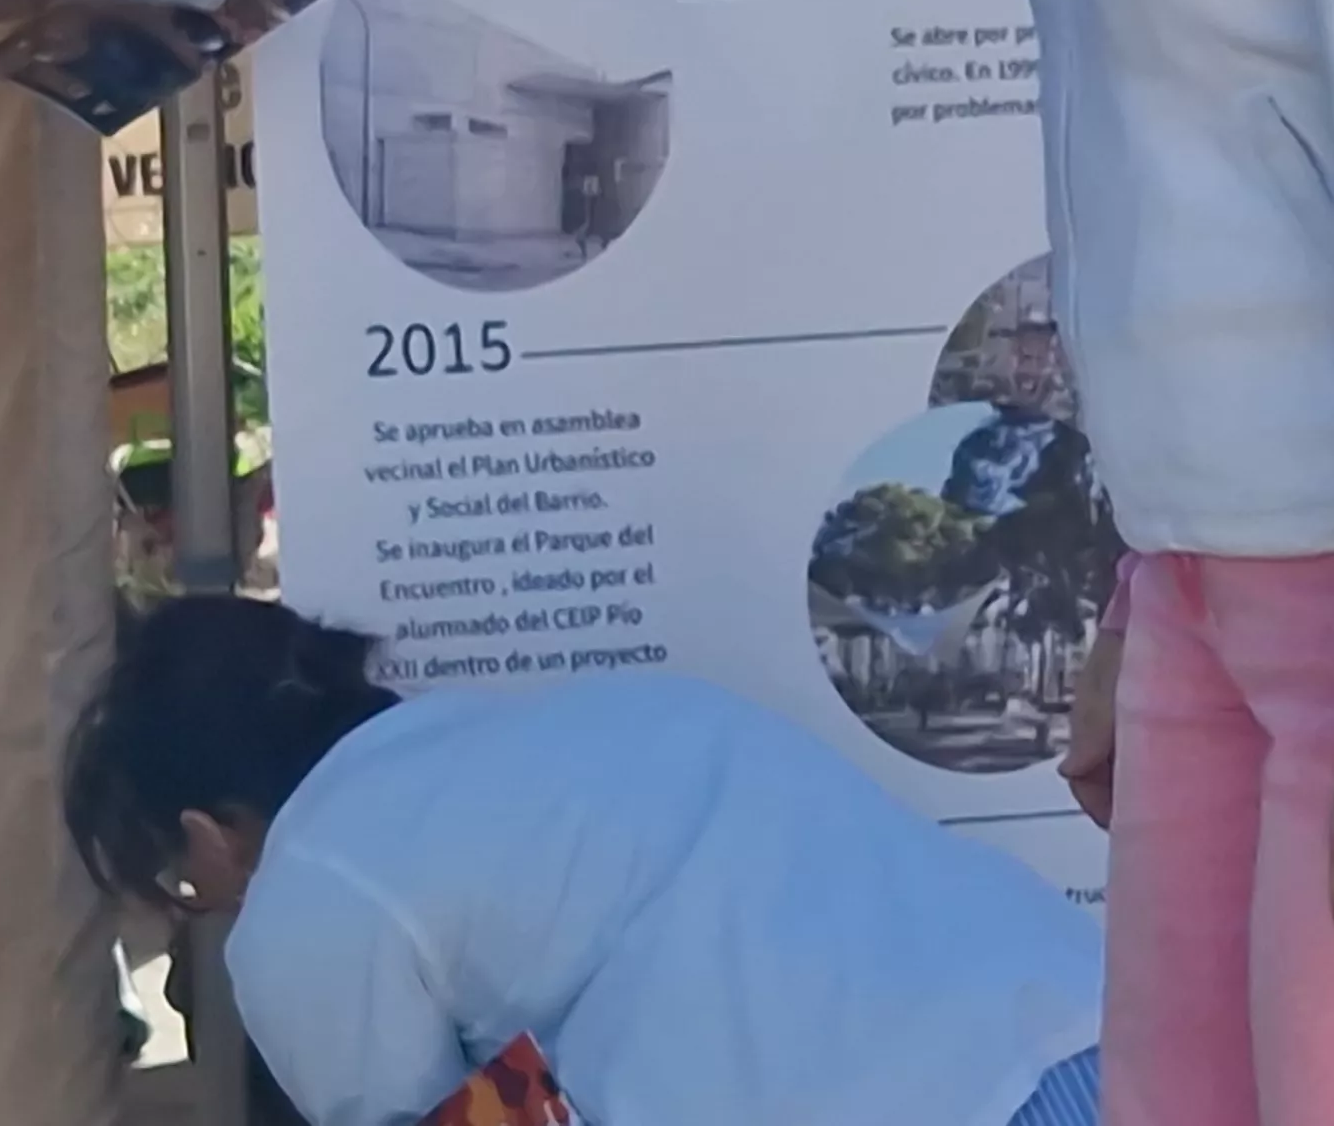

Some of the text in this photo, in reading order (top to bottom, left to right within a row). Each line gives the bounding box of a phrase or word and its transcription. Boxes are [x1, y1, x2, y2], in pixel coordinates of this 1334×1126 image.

[932, 96, 1036, 124] problema
[366, 320, 511, 377] 2015
[374, 409, 641, 445] Se aprueba en asamblea
[365, 446, 656, 483] vecinal el Plan Urbanístico
[408, 490, 609, 524] y Social del Barrio.
[376, 524, 654, 563] Se inaugura el Parque del
[379, 575, 496, 602] Encuentro
[512, 569, 586, 593] ideado
[591, 567, 628, 592] por
[633, 562, 655, 585] el
[395, 601, 643, 641] alumnado del CEIP Pío
[423, 654, 501, 678] dentro
[505, 650, 534, 673] de
[539, 651, 566, 670] un
[571, 644, 668, 672] proyecto
